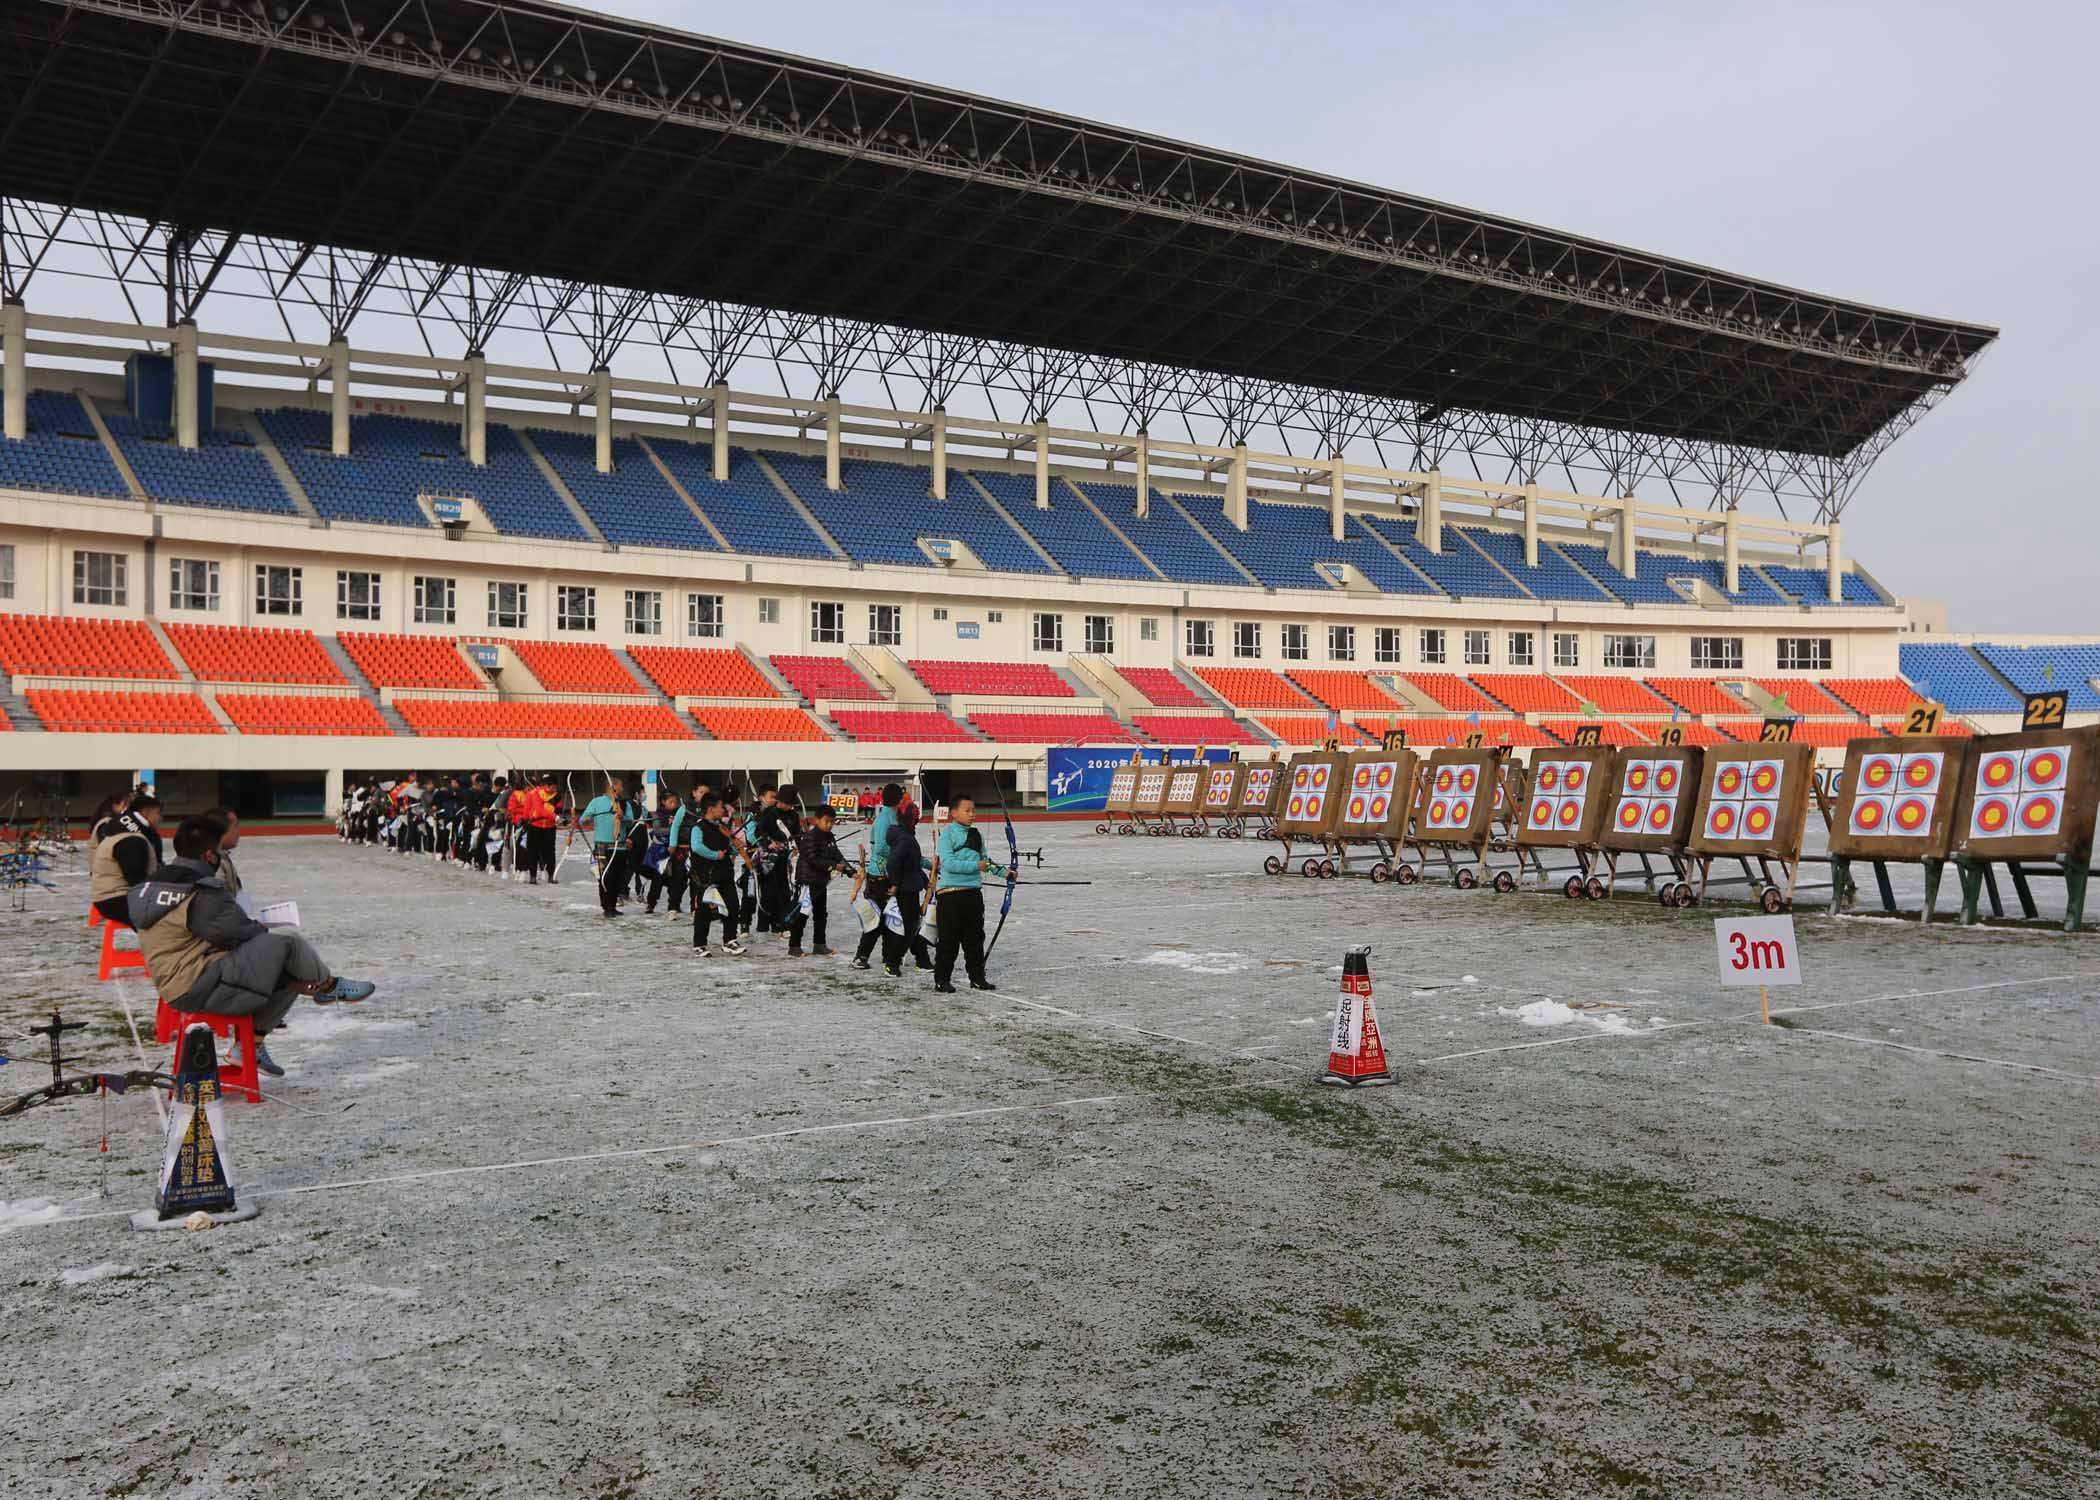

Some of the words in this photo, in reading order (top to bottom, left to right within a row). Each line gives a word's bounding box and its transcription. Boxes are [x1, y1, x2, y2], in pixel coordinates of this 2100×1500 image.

[2027, 697, 2065, 724] 22
[1907, 708, 1938, 734] 21
[1466, 734, 1482, 748] 17
[1575, 730, 1598, 746] 18
[1661, 728, 1681, 746] 19
[1763, 724, 1789, 742] 20
[1325, 739, 1337, 752] 15
[1385, 734, 1401, 751] 16
[1163, 754, 1168, 765] 6
[830, 795, 854, 808] 220
[1729, 931, 1785, 970] 3m
